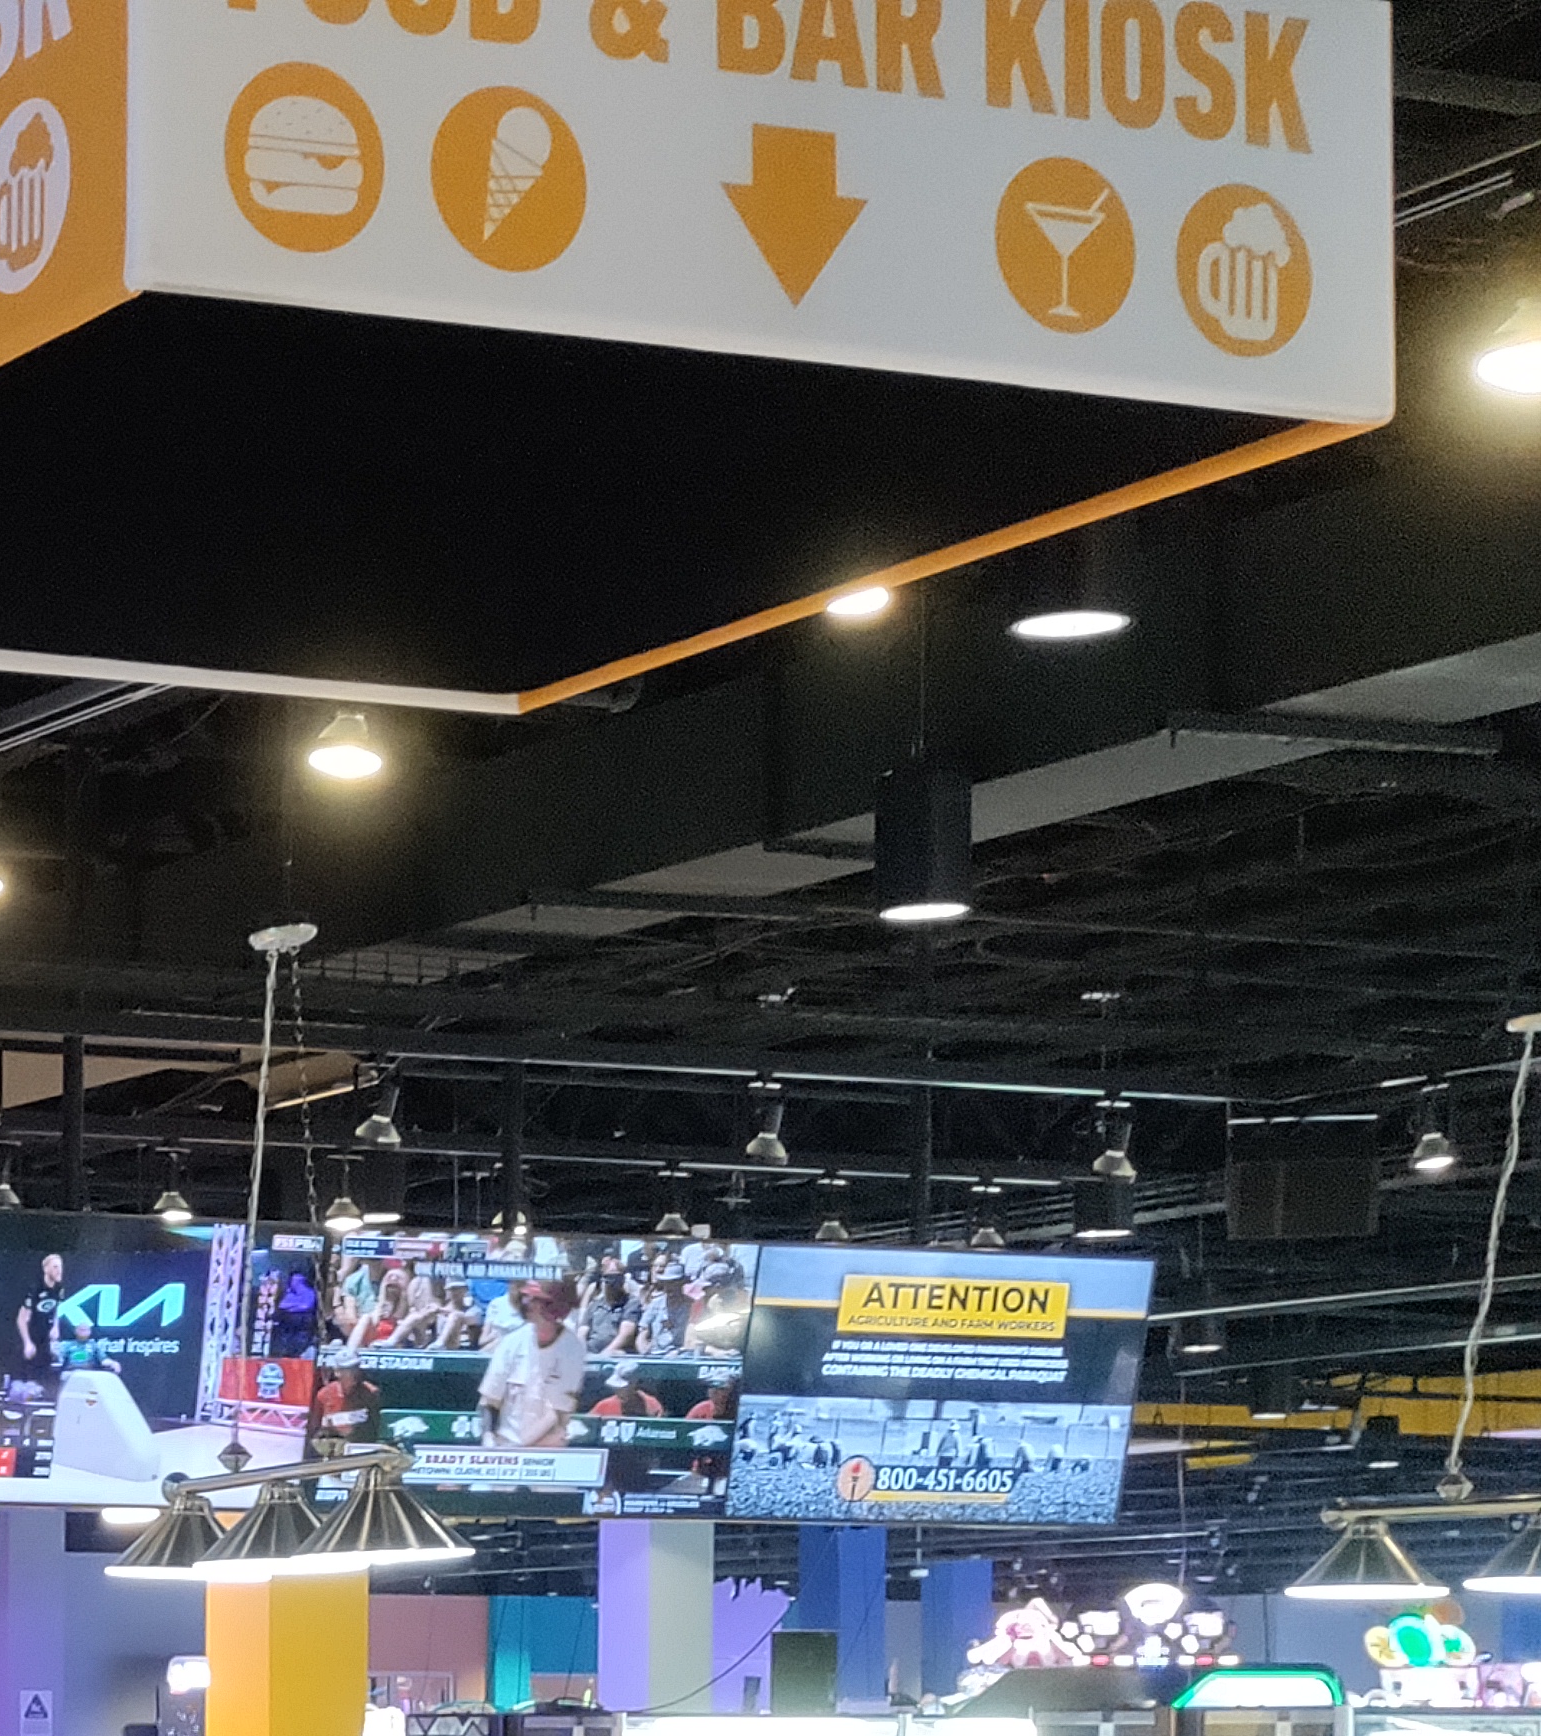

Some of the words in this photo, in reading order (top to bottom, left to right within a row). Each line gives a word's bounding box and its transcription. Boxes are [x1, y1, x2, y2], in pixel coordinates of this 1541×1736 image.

[717, 0, 945, 99] BAR
[985, 0, 1313, 154] KIOSK
[862, 1282, 1050, 1314] ATTENTION
[848, 1315, 929, 1328] AGRICULTURE
[932, 1317, 957, 1329] AND
[961, 1318, 993, 1330] FARM
[997, 1320, 1055, 1332] WORKERS
[126, 1336, 180, 1356] inspires
[890, 1366, 910, 1377] THE
[425, 1455, 465, 1465] BRADY
[470, 1456, 519, 1466] SLAVENS
[876, 1466, 1015, 1493] 800-451-6605
